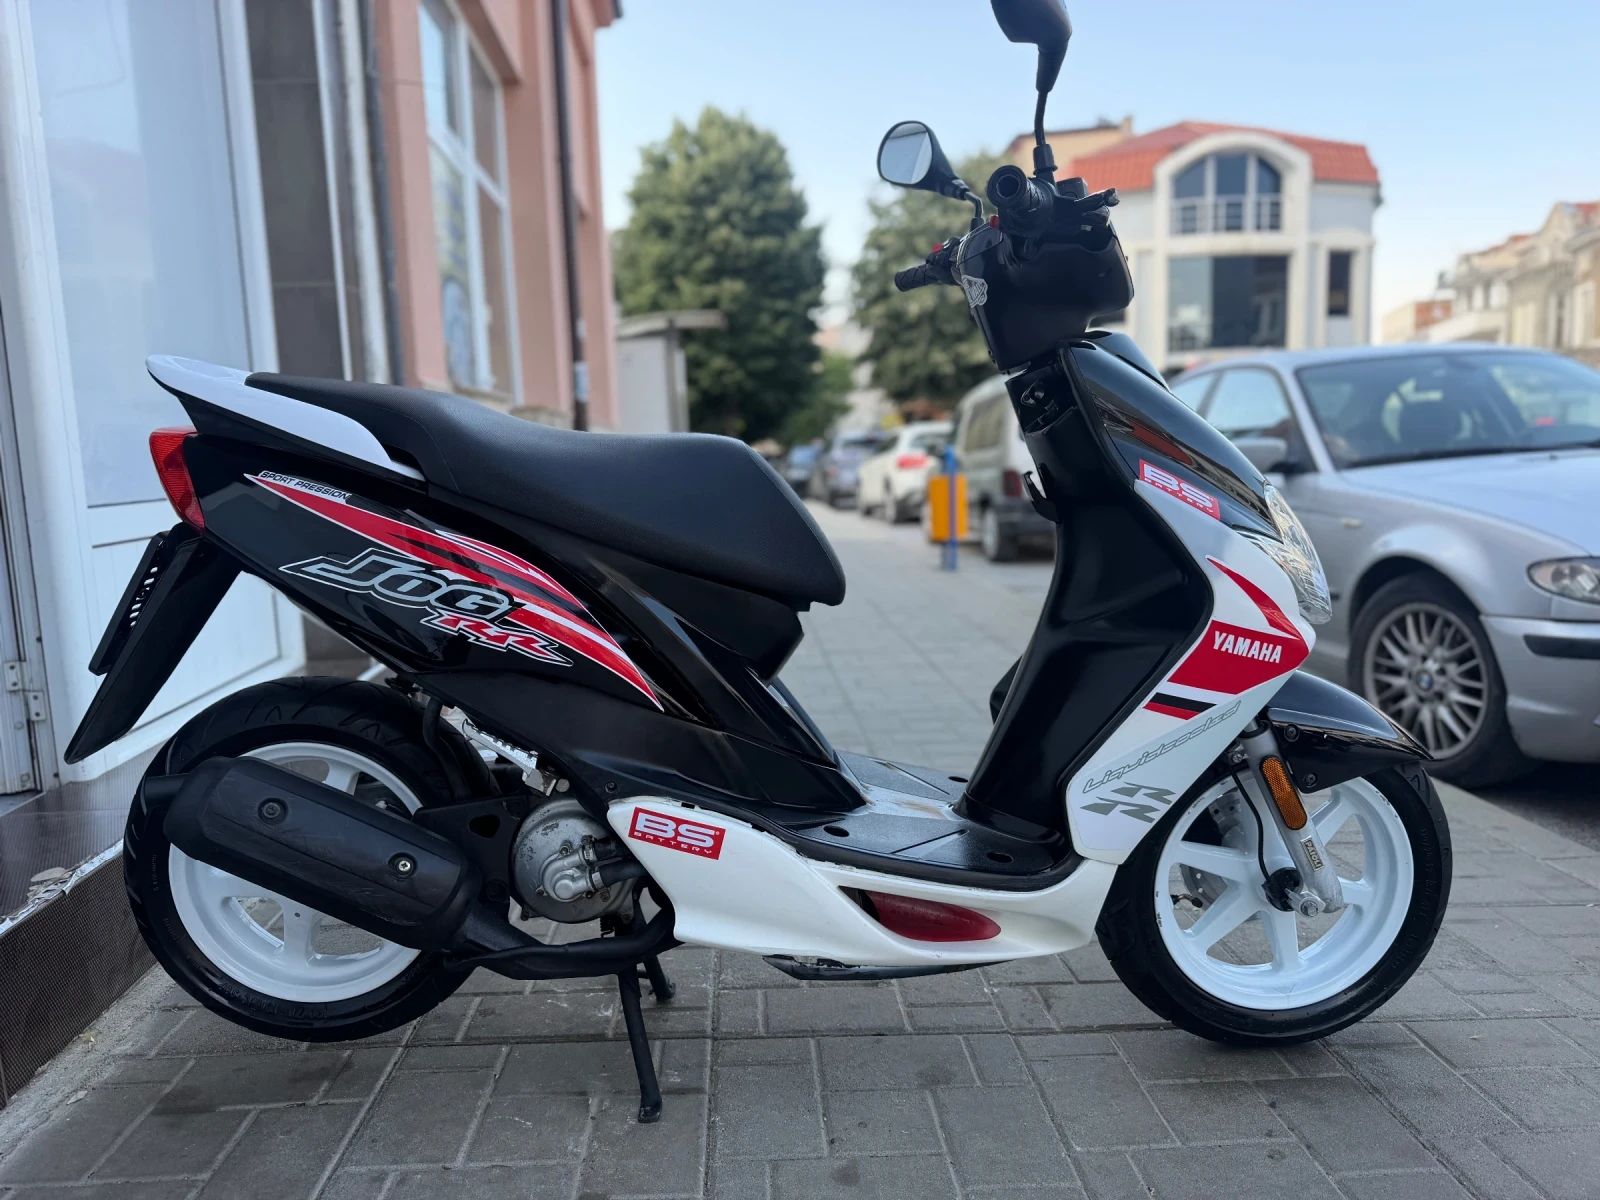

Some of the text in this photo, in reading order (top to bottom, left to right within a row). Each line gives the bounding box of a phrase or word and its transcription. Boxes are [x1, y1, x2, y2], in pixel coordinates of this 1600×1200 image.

[260, 470, 351, 500] SPORT PRESSION
[1143, 463, 1213, 508] BS
[1212, 630, 1283, 664] YAMAHA
[633, 831, 712, 854] BATTERY
[635, 812, 715, 848] BS
[1304, 839, 1322, 869] PAIOLI
